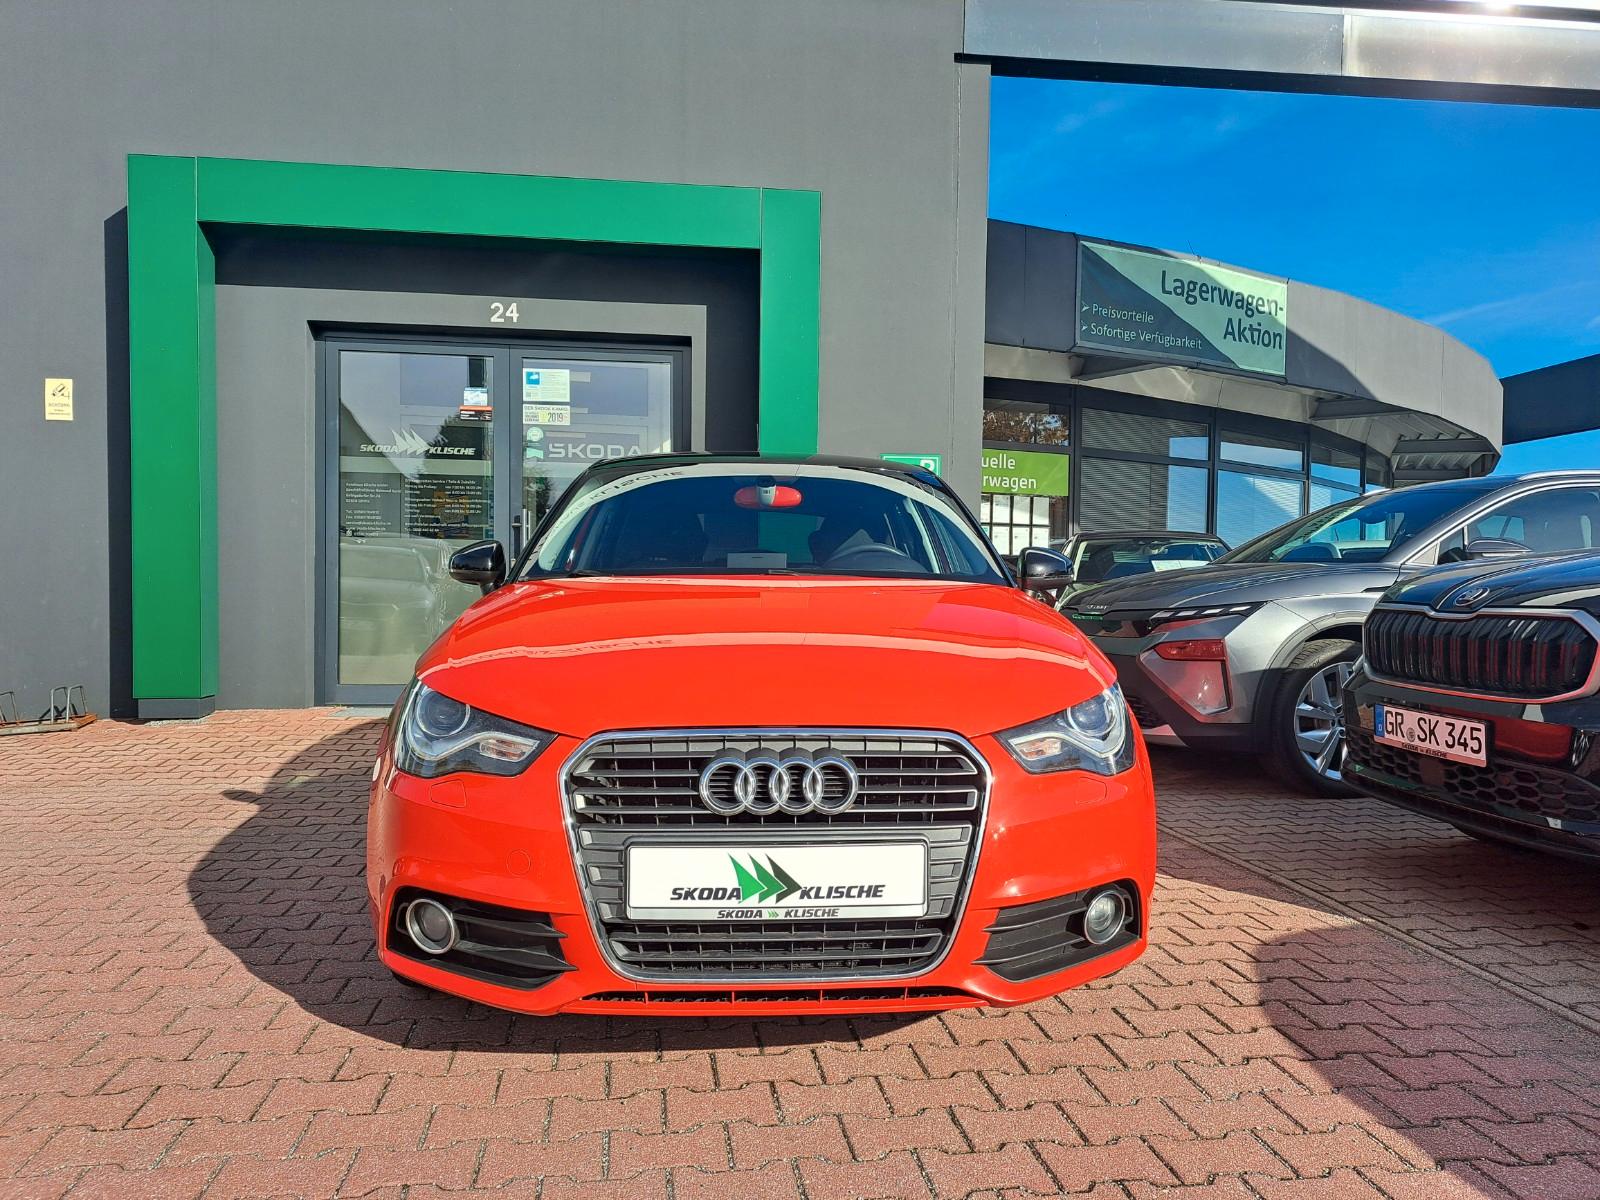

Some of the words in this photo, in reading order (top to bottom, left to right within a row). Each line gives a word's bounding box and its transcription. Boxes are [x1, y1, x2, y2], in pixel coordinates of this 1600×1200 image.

[1161, 269, 1284, 318] Lagerwagen-
[490, 302, 520, 323] 24
[1092, 303, 1154, 324] Preisvorteile
[1090, 322, 1137, 341] Sofortige
[1138, 331, 1203, 350] Verfügbarkeit
[1223, 317, 1283, 350] Aktion
[428, 446, 476, 456] KLISCHE
[1384, 710, 1405, 738] GR
[1417, 717, 1440, 746] SK
[1444, 722, 1482, 754] 345
[799, 884, 886, 900] KLISCHE
[784, 908, 839, 918] KLISCHE
